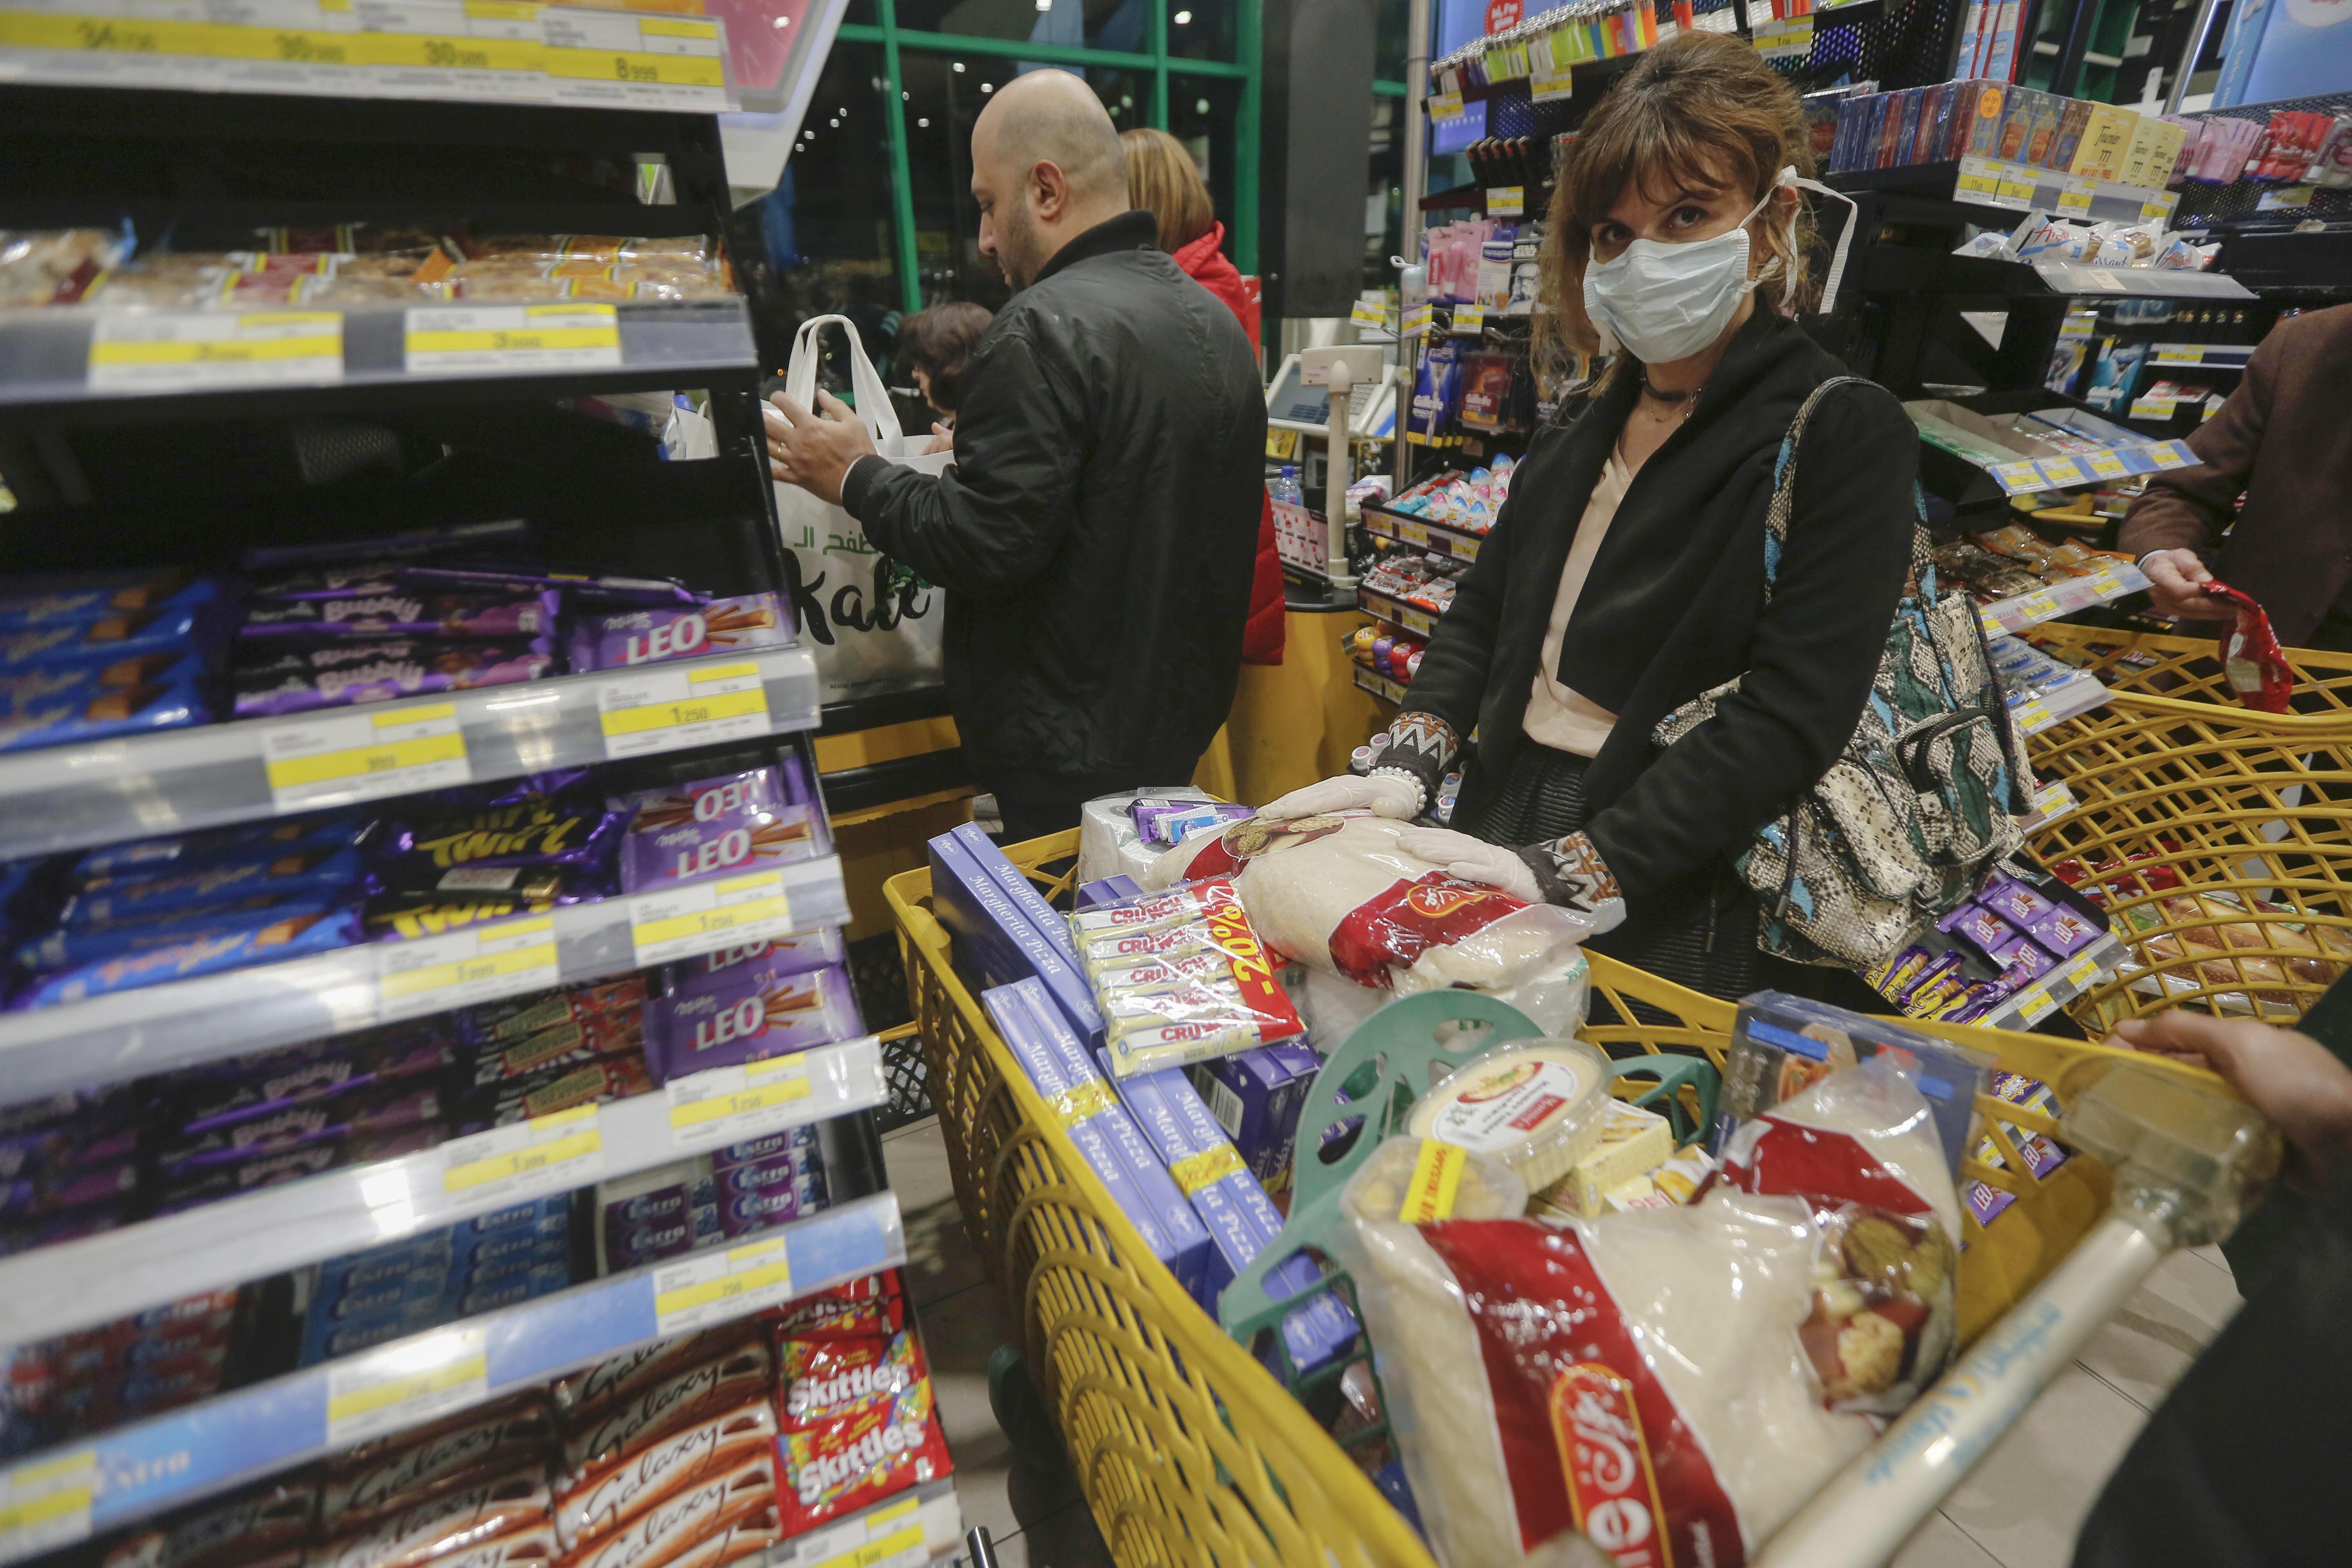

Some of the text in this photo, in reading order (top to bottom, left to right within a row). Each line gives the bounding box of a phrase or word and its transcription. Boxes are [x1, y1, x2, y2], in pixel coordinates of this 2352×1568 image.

[2094, 125, 2121, 146] Fournier
[2099, 150, 2112, 163] 777
[2131, 161, 2143, 173] 777
[1413, 394, 1444, 412] Gillette
[1465, 393, 1492, 407] Gillette
[1373, 578, 1398, 589] bueno
[627, 614, 707, 665] LEO
[677, 829, 751, 880] LEO
[994, 863, 1057, 927] Margherita
[1110, 896, 1184, 924] CRUNCH
[969, 875, 1030, 938] Margherita
[1026, 938, 1061, 975] Pizza
[696, 996, 766, 1051] LEO
[1081, 1129, 1120, 1182] Pizza
[1112, 1113, 1151, 1169] Pizza
[2022, 1144, 2041, 1171] LEO
[1973, 1183, 1993, 1212] LEO
[588, 1363, 722, 1461] Galaxy
[787, 1363, 911, 1416] Skittles
[585, 1423, 722, 1525] Galaxy
[799, 1421, 925, 1506] Skittles
[600, 1479, 729, 1568] Galaxy
